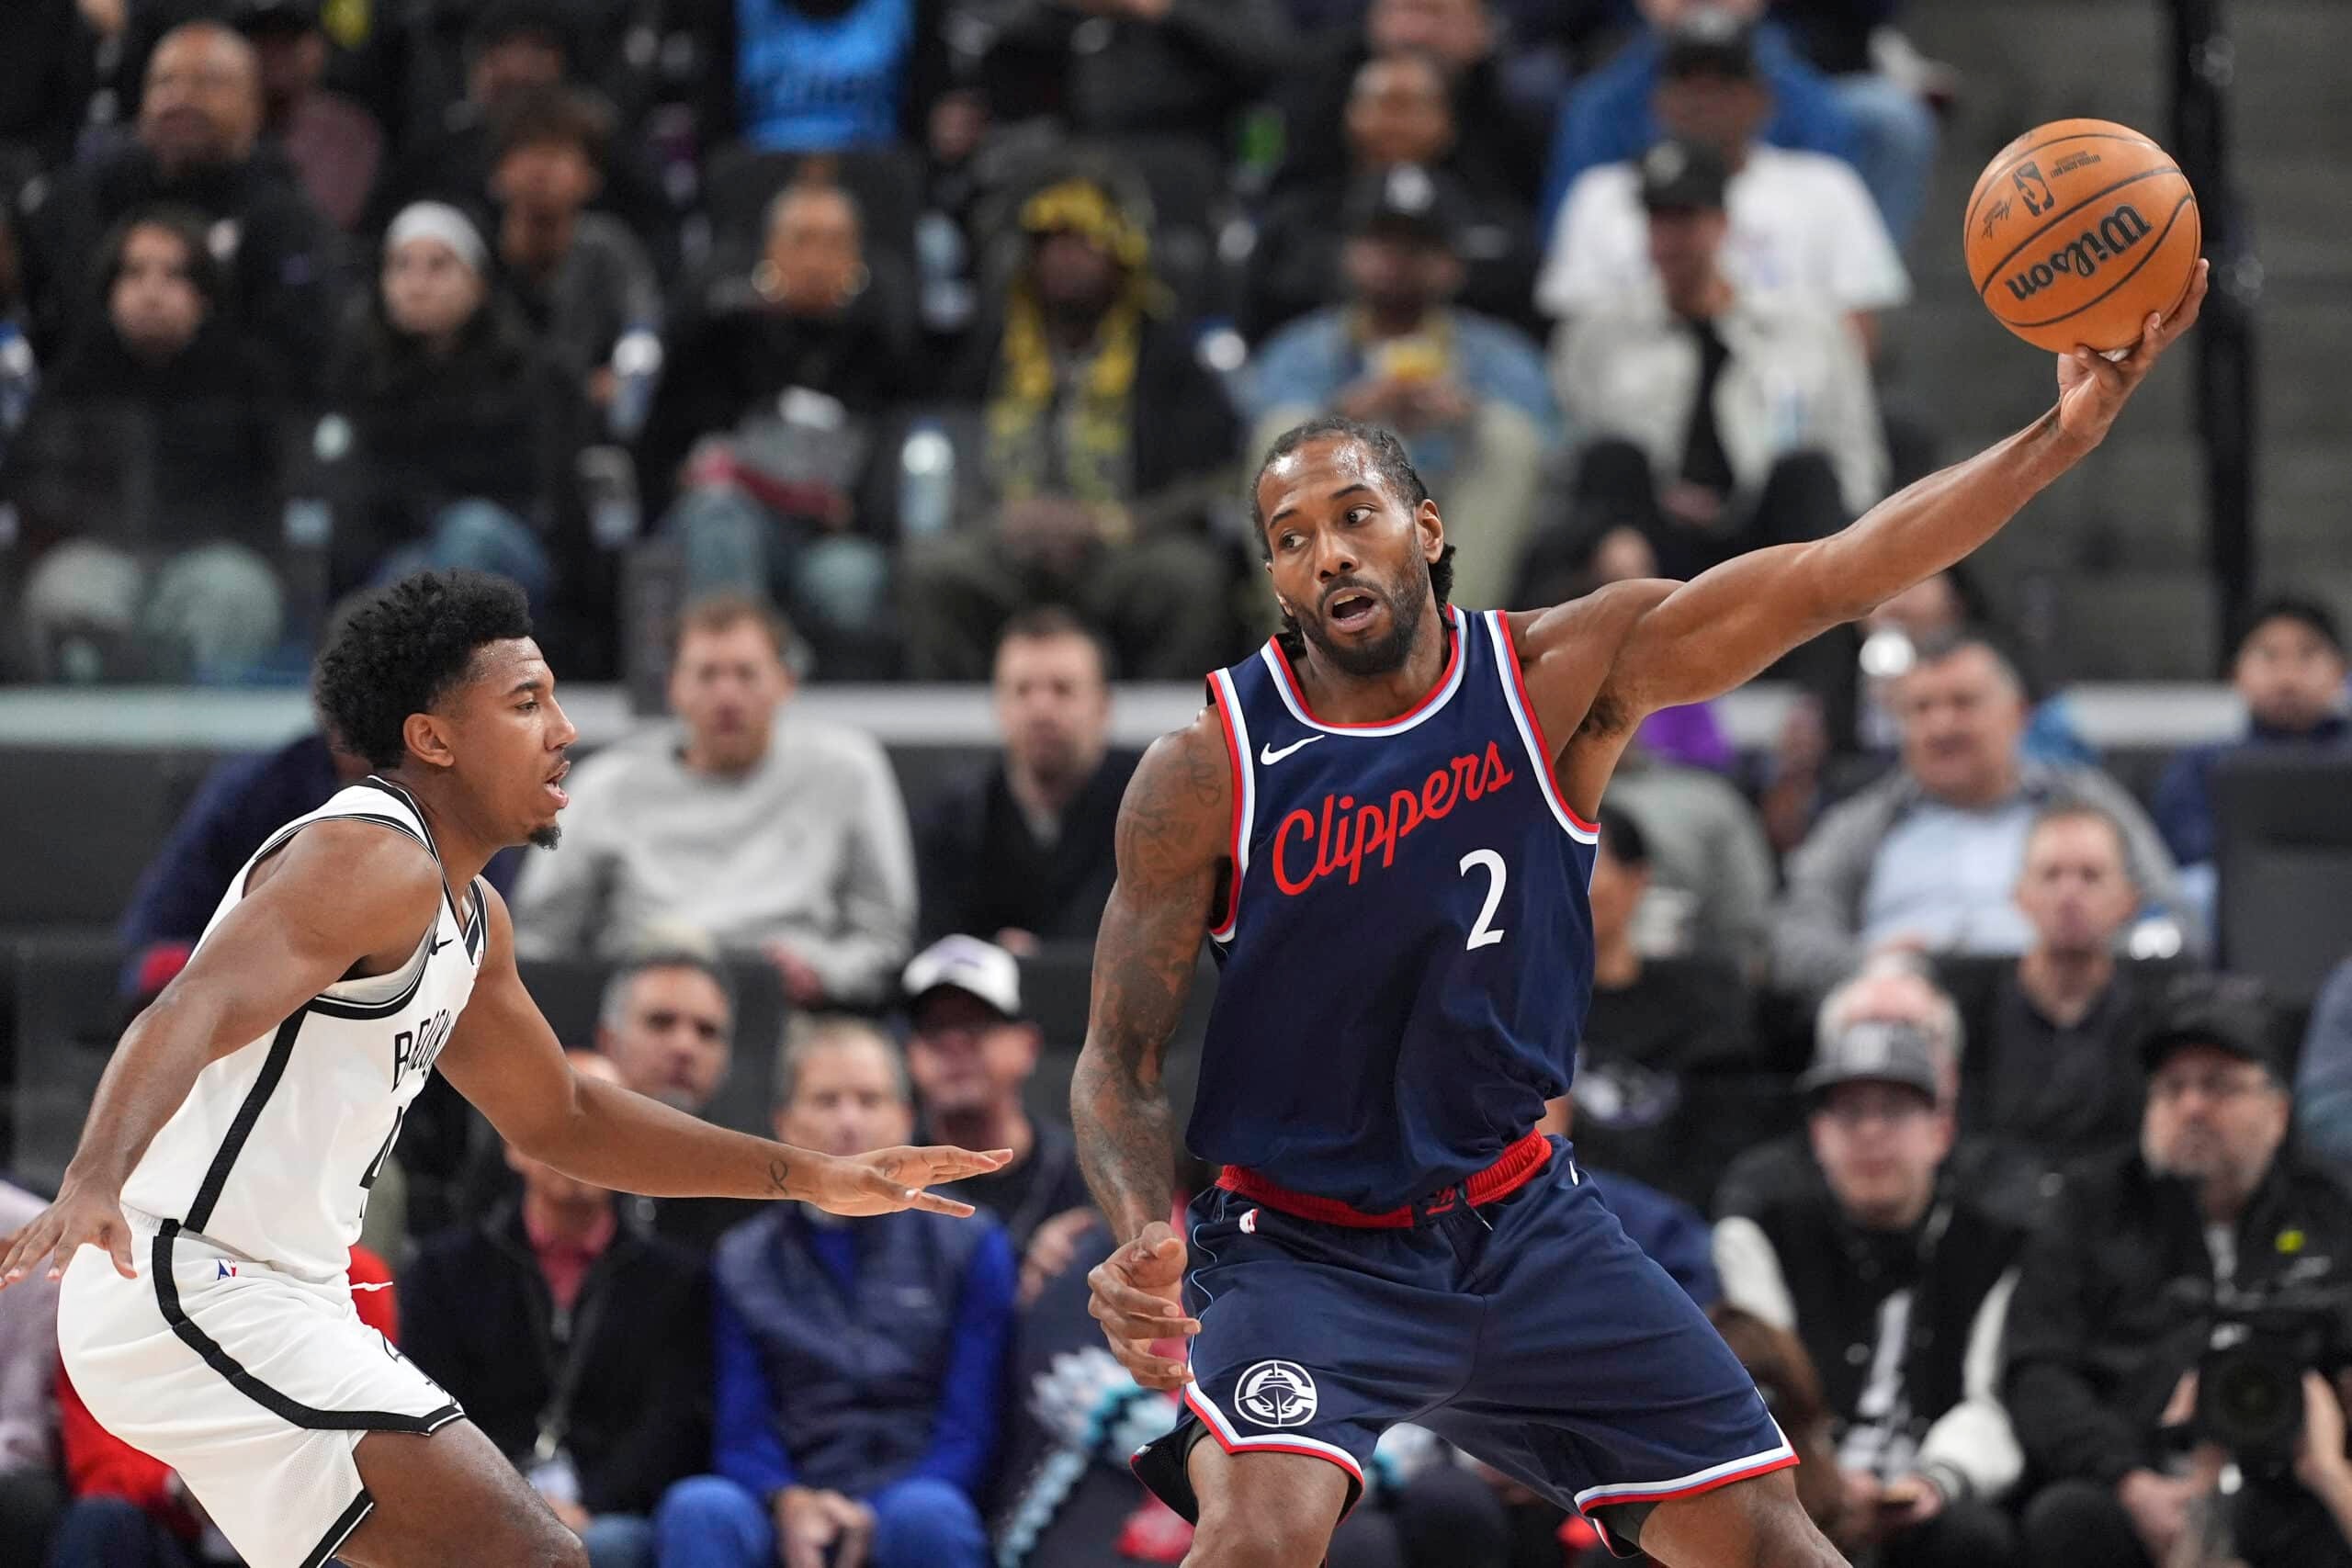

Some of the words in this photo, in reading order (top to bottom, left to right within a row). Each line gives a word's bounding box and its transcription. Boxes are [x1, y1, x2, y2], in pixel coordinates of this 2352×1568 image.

[2005, 205, 2154, 301] Wilson
[1272, 740, 1514, 897] Clippers
[1459, 848, 1508, 952] 2
